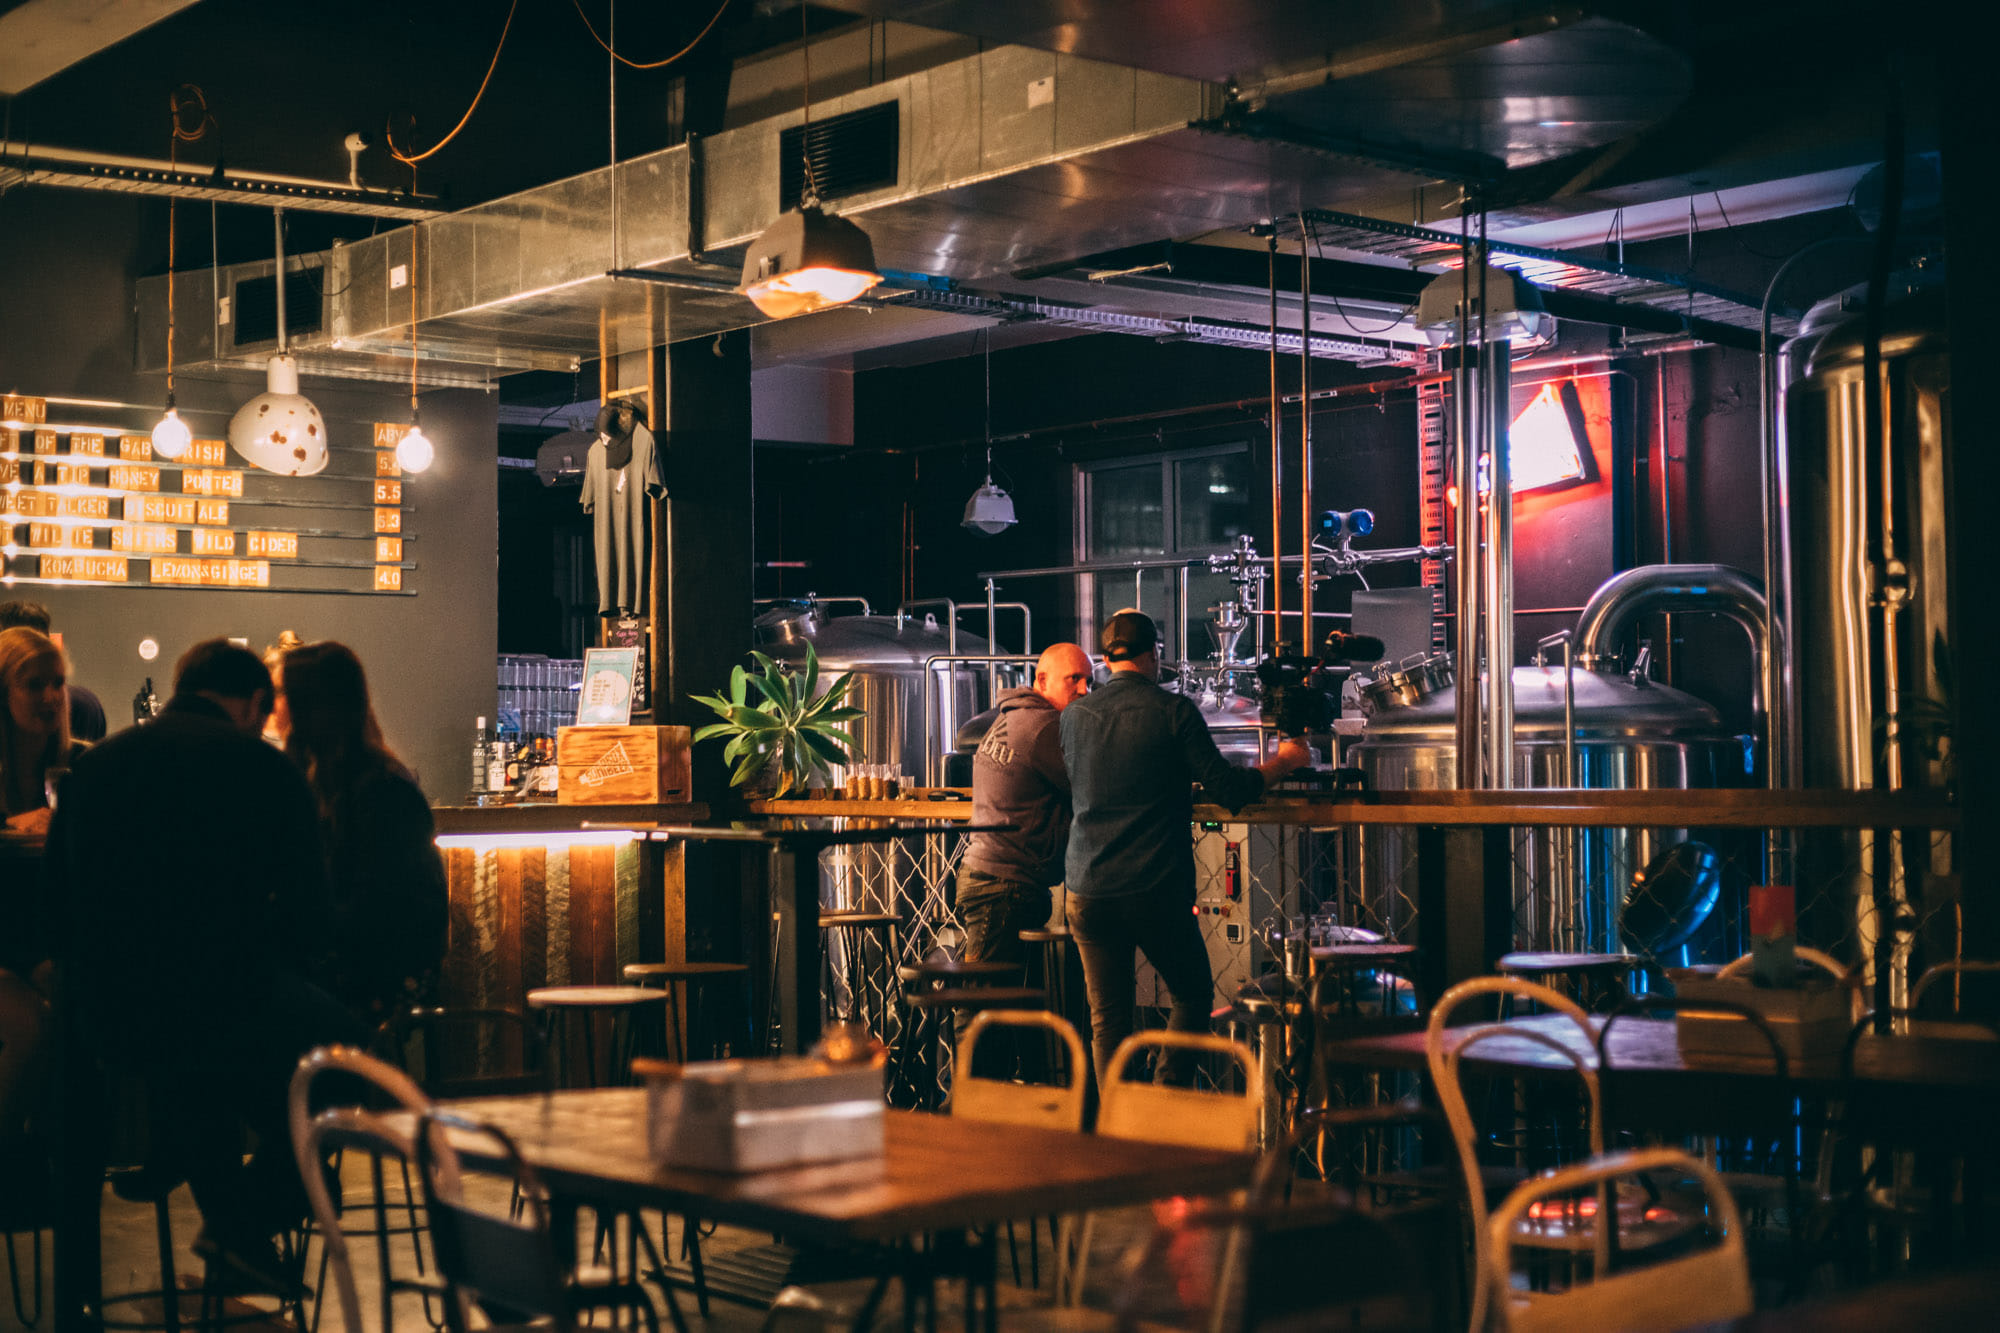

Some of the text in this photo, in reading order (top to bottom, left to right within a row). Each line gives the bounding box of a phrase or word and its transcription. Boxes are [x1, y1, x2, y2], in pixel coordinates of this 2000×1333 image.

[4, 402, 45, 418] MENU
[377, 428, 404, 443] ABV
[36, 435, 55, 450] OF
[71, 437, 101, 453] THE
[120, 438, 151, 455] GAB
[183, 444, 224, 462] RISH
[35, 466, 45, 481] A
[57, 466, 88, 482] TIP
[110, 469, 158, 487] HONEY
[183, 473, 242, 492] PORTER
[377, 485, 401, 499] 5.5
[48, 496, 108, 514] TALKER
[125, 500, 194, 518] BISCUIT
[198, 505, 227, 520] ALE
[31, 527, 92, 544] WILIE
[193, 534, 233, 550] WILD
[250, 536, 297, 552] CIDER
[42, 559, 126, 576] KOMBUCHA
[379, 571, 400, 585] 4.0
